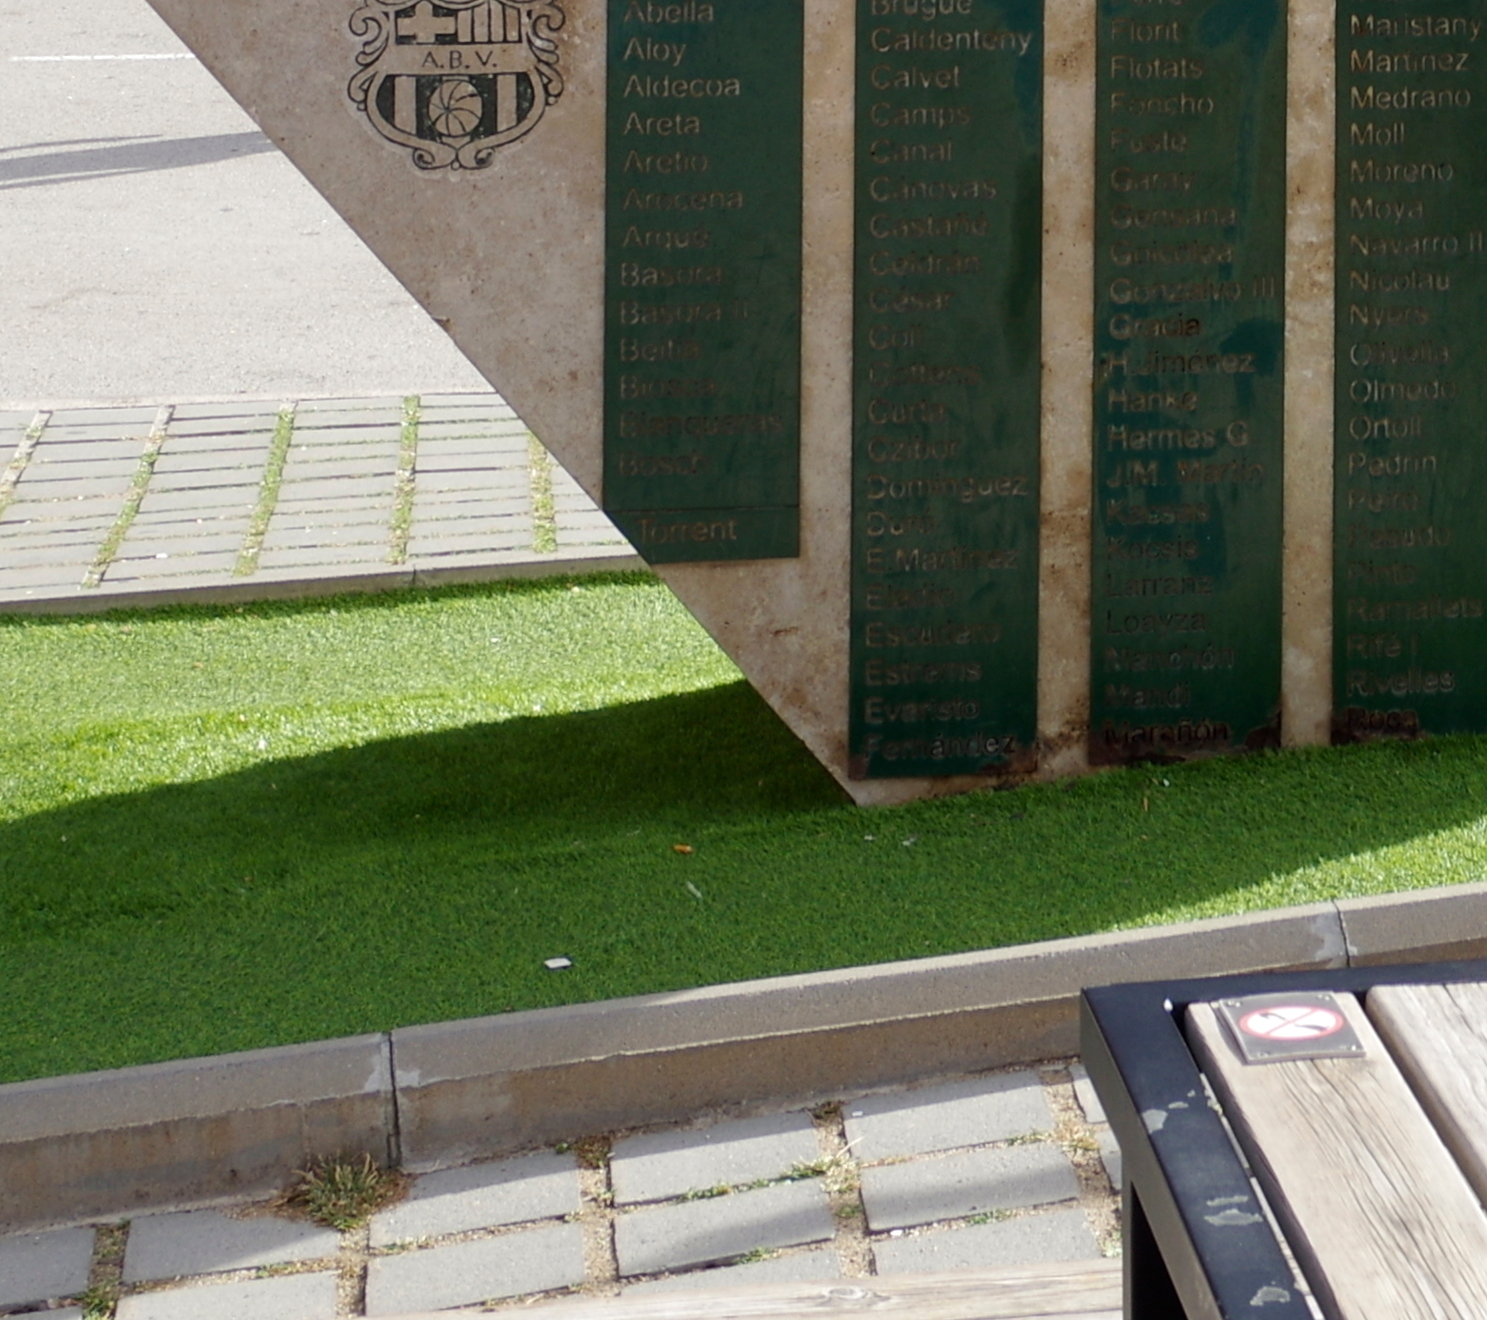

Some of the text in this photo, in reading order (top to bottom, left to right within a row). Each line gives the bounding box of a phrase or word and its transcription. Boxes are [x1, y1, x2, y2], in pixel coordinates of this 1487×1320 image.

[622, 0, 715, 25] Abella
[1350, 14, 1482, 40] Maristany
[622, 37, 687, 67] Aloy
[870, 64, 961, 90] Calvet
[1110, 55, 1204, 81] Flotats
[623, 74, 742, 99] Aldecoa
[1350, 85, 1471, 110] Medrano
[623, 112, 701, 137] Areta
[870, 101, 972, 129] Camps
[1350, 122, 1406, 146] Moll
[870, 139, 952, 164] Canal
[1350, 159, 1455, 184] Moreno
[1350, 233, 1458, 257] Navarro
[620, 262, 722, 287] Basora
[1350, 270, 1452, 294] Nicolau
[864, 696, 979, 724] Evaristo
